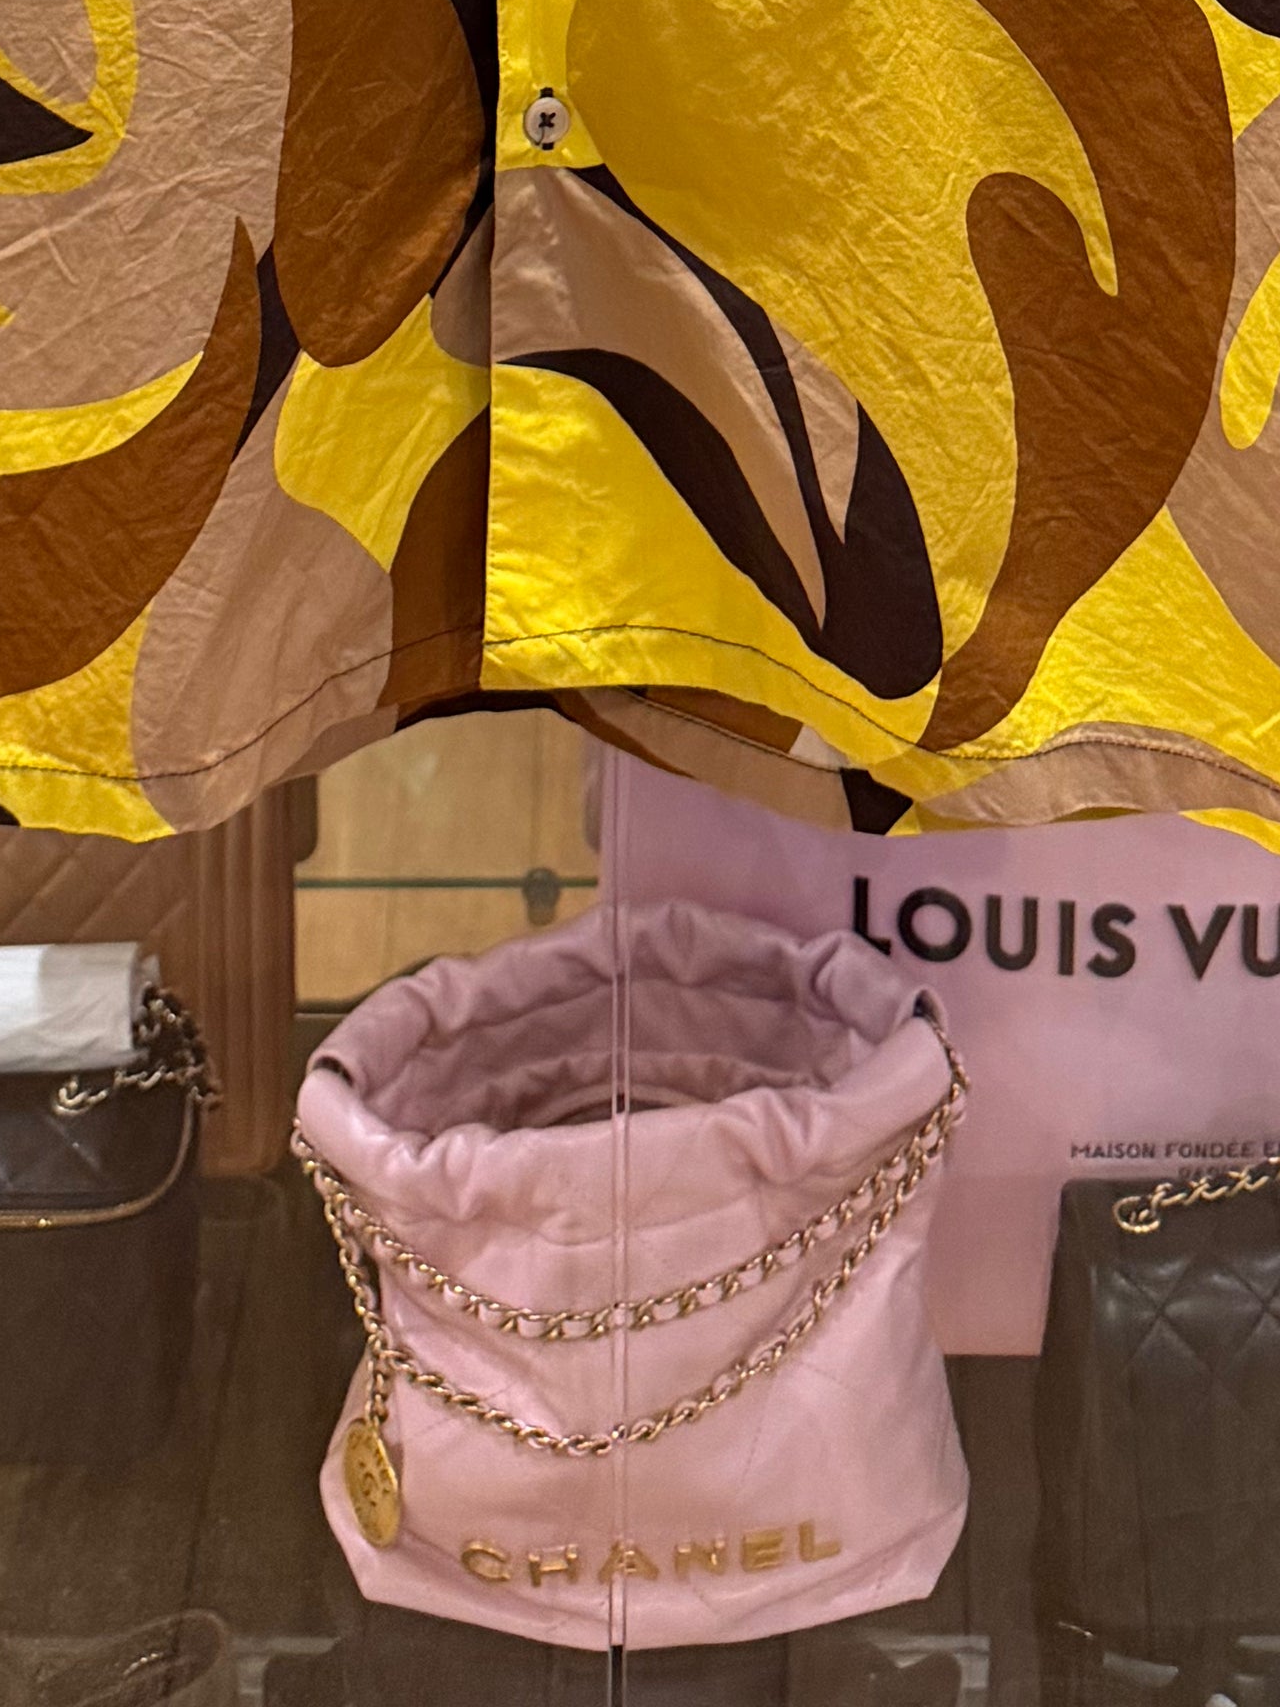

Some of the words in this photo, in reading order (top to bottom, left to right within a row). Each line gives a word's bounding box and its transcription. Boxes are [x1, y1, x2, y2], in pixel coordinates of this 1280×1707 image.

[851, 876, 1138, 979] LOUIS
[1070, 1141, 1156, 1159] MAISON
[460, 1520, 842, 1588] CHANEL
